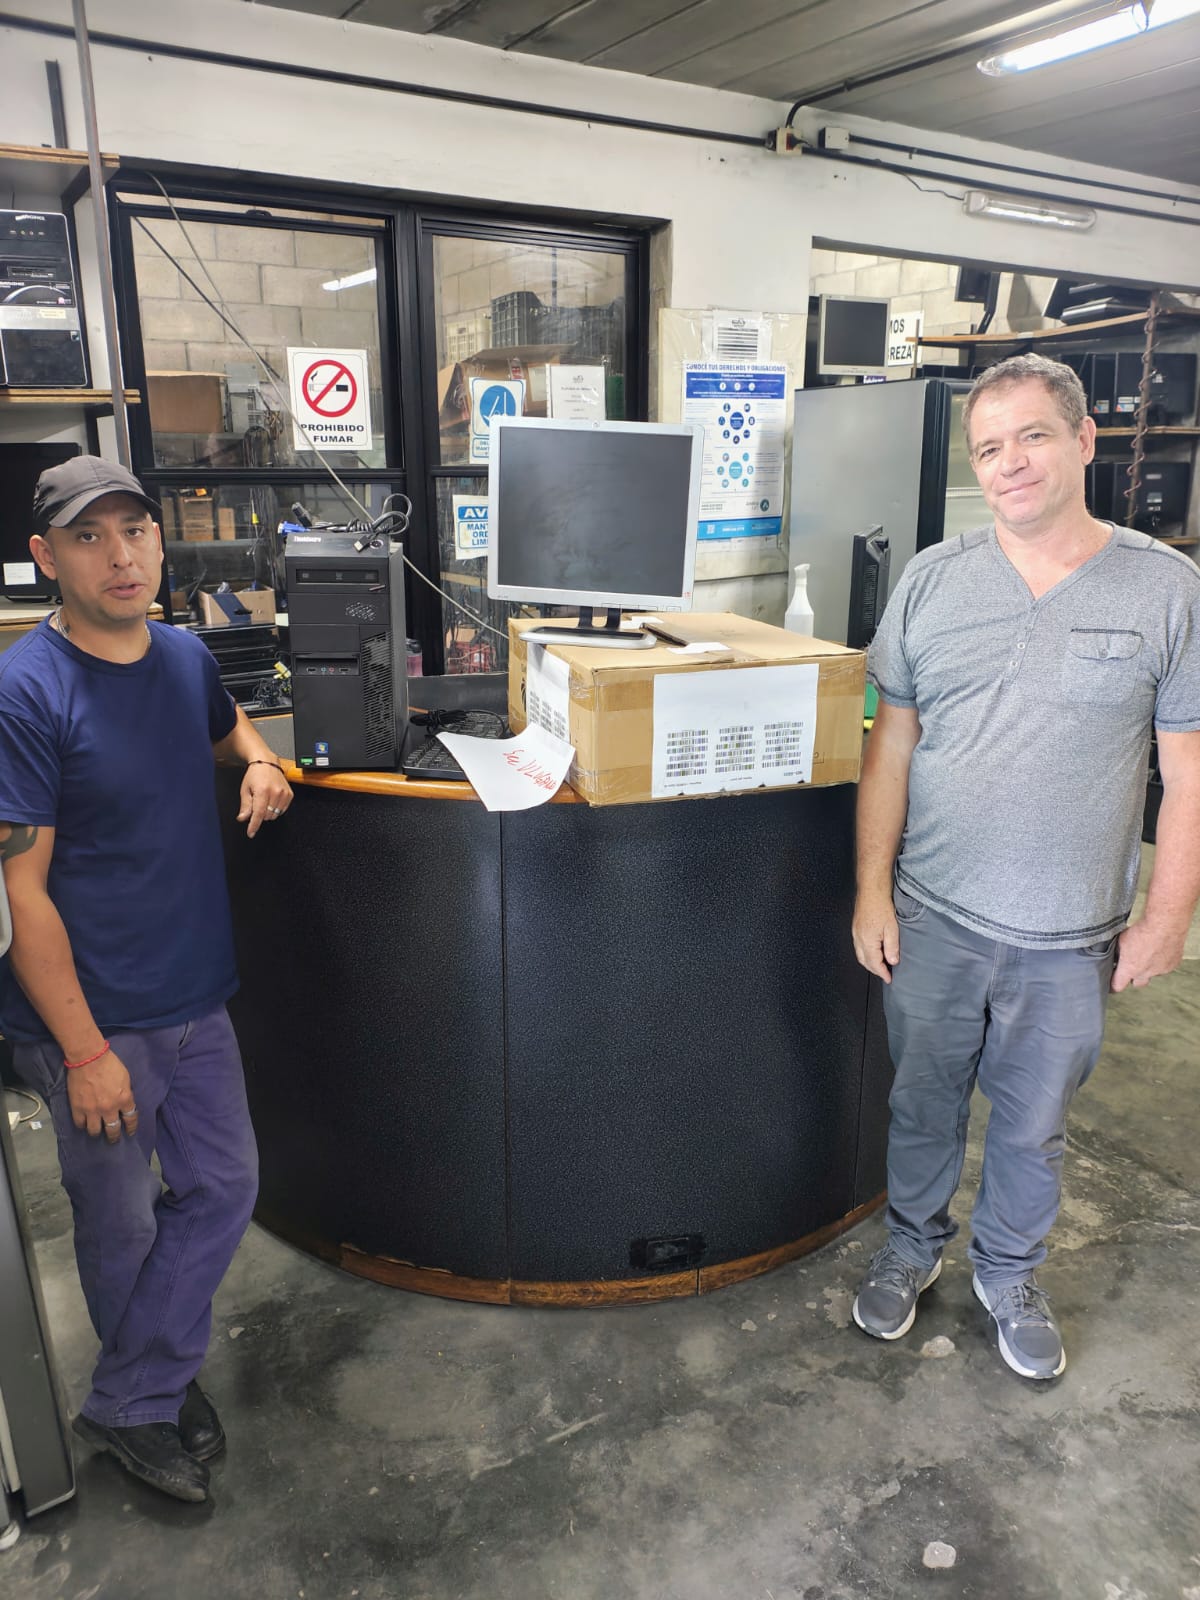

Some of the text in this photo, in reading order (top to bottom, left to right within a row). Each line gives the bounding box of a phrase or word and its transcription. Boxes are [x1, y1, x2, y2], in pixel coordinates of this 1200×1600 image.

[888, 345, 915, 360] REZA"
[300, 424, 365, 432] PROHIBIDO
[313, 435, 354, 443] FUMAR
[464, 508, 488, 518] AV
